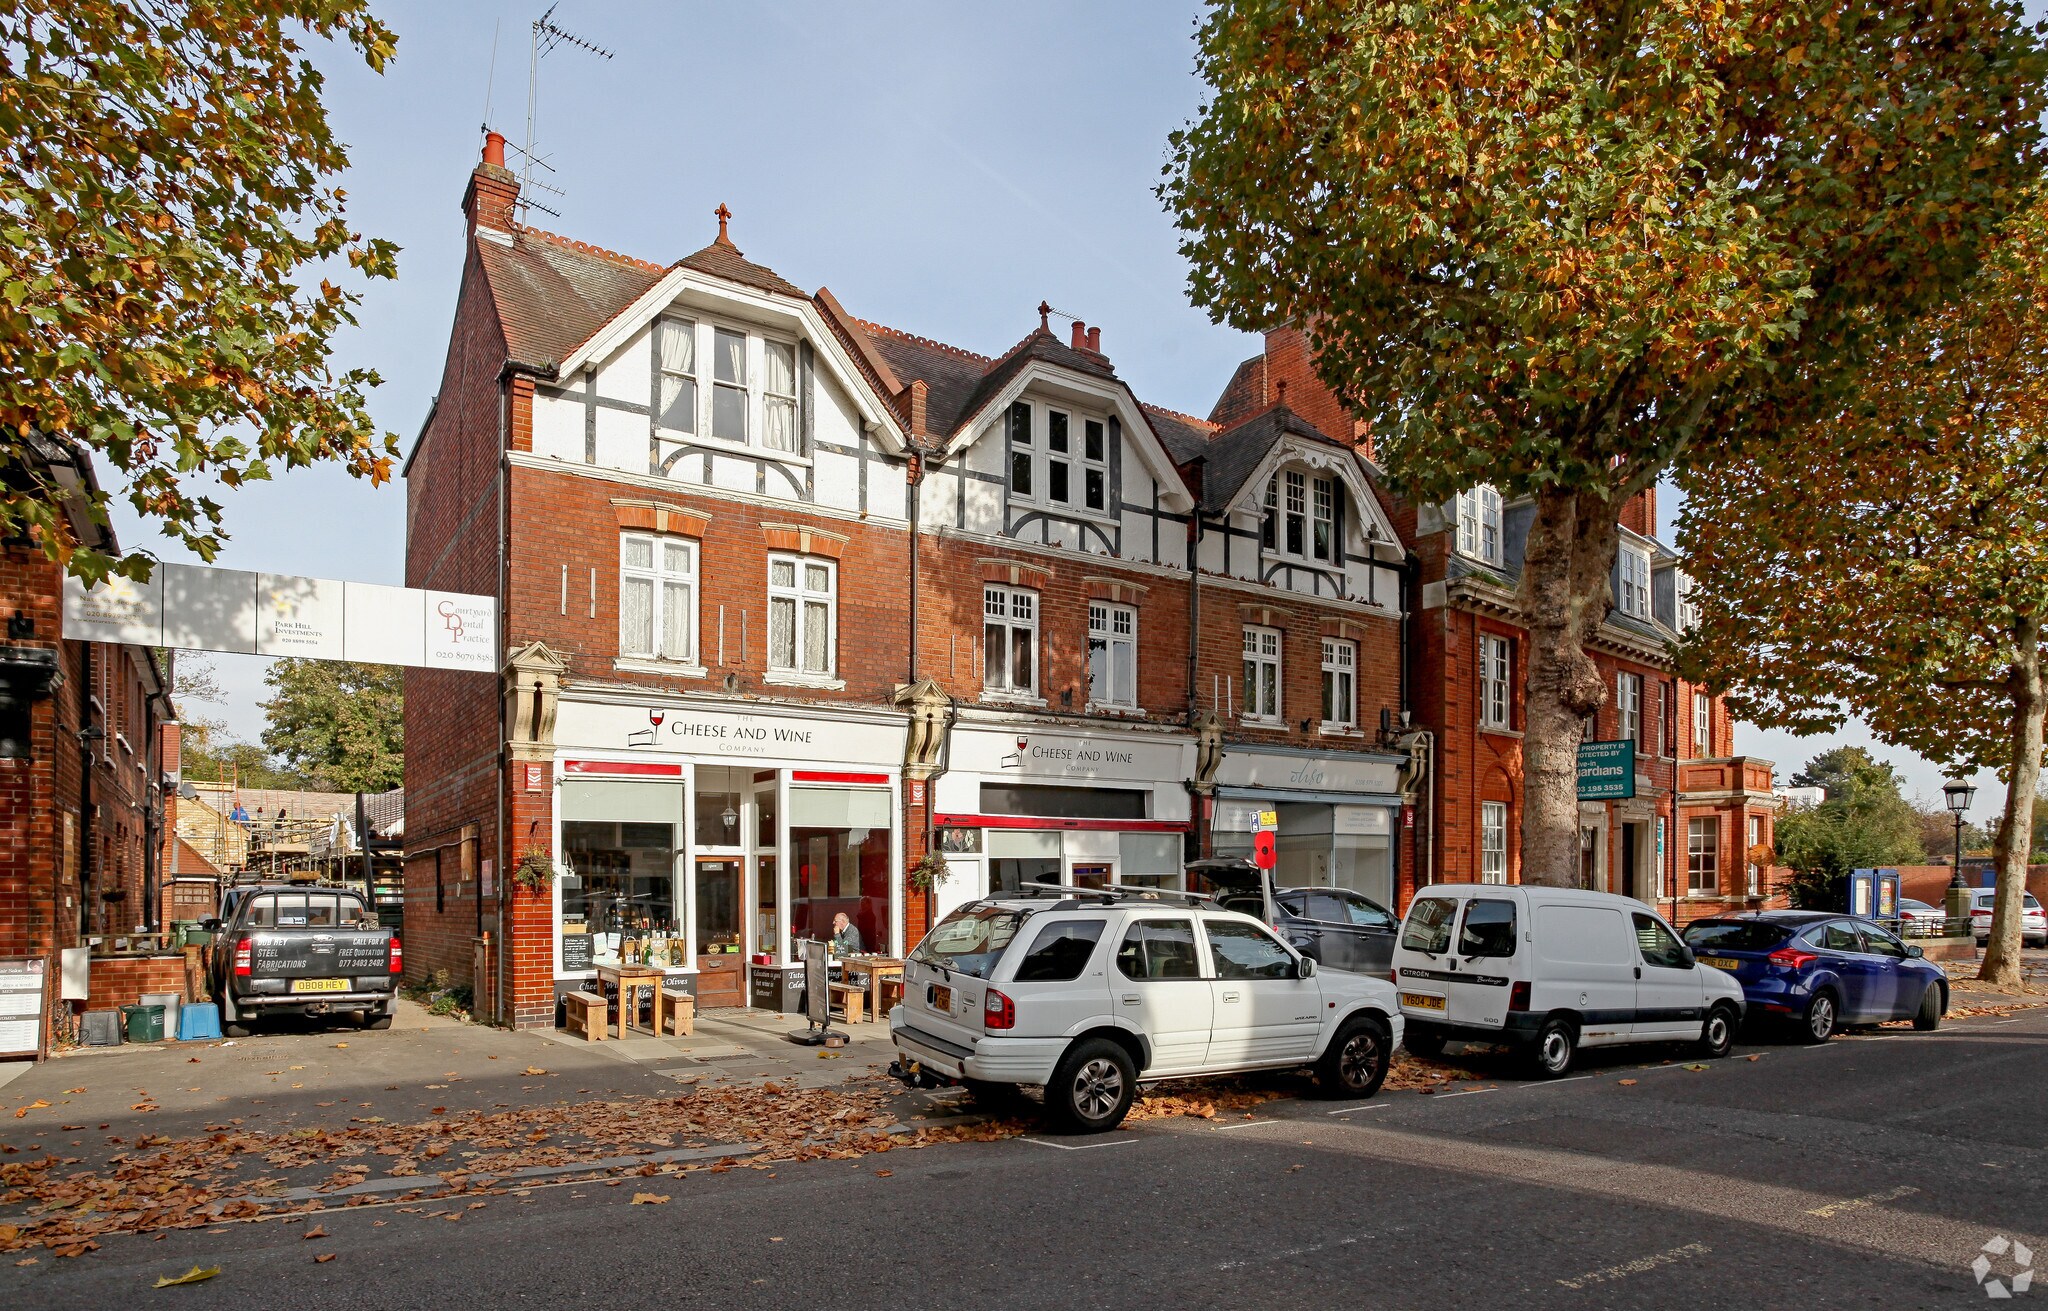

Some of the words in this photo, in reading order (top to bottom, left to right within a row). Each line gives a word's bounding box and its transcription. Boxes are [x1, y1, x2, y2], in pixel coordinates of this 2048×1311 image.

[438, 601, 492, 618] Courtyard
[275, 620, 293, 628] PARK
[295, 622, 312, 630] HILL
[444, 613, 484, 630] Dental
[275, 627, 323, 637] INVESTMENTS
[451, 626, 490, 643] Practice
[436, 651, 453, 659] 020
[456, 651, 475, 661] 8979
[671, 721, 728, 738] CHEESE
[733, 727, 767, 741] AND
[773, 728, 812, 744] WINE
[718, 743, 765, 753] COMPANY
[1581, 743, 1617, 751] PROPERTY
[1032, 745, 1072, 760] CHEESE
[1076, 750, 1101, 762] AND
[1105, 750, 1133, 763] WINE
[1577, 750, 1610, 758] ROTECTED
[1065, 764, 1100, 772] COMPANY
[257, 948, 279, 957] STEEL
[338, 948, 354, 956] FREE
[353, 948, 385, 957] QUOTATION
[256, 959, 307, 969] FABRICATIONS
[338, 959, 351, 968] 077
[1402, 969, 1430, 978] CITROËN
[299, 981, 324, 990] OB08
[325, 980, 345, 989] HEY
[666, 977, 688, 986] Olives
[1476, 975, 1502, 985] Berlingo
[1406, 995, 1425, 1006] Y604
[1426, 997, 1441, 1009] JDE
